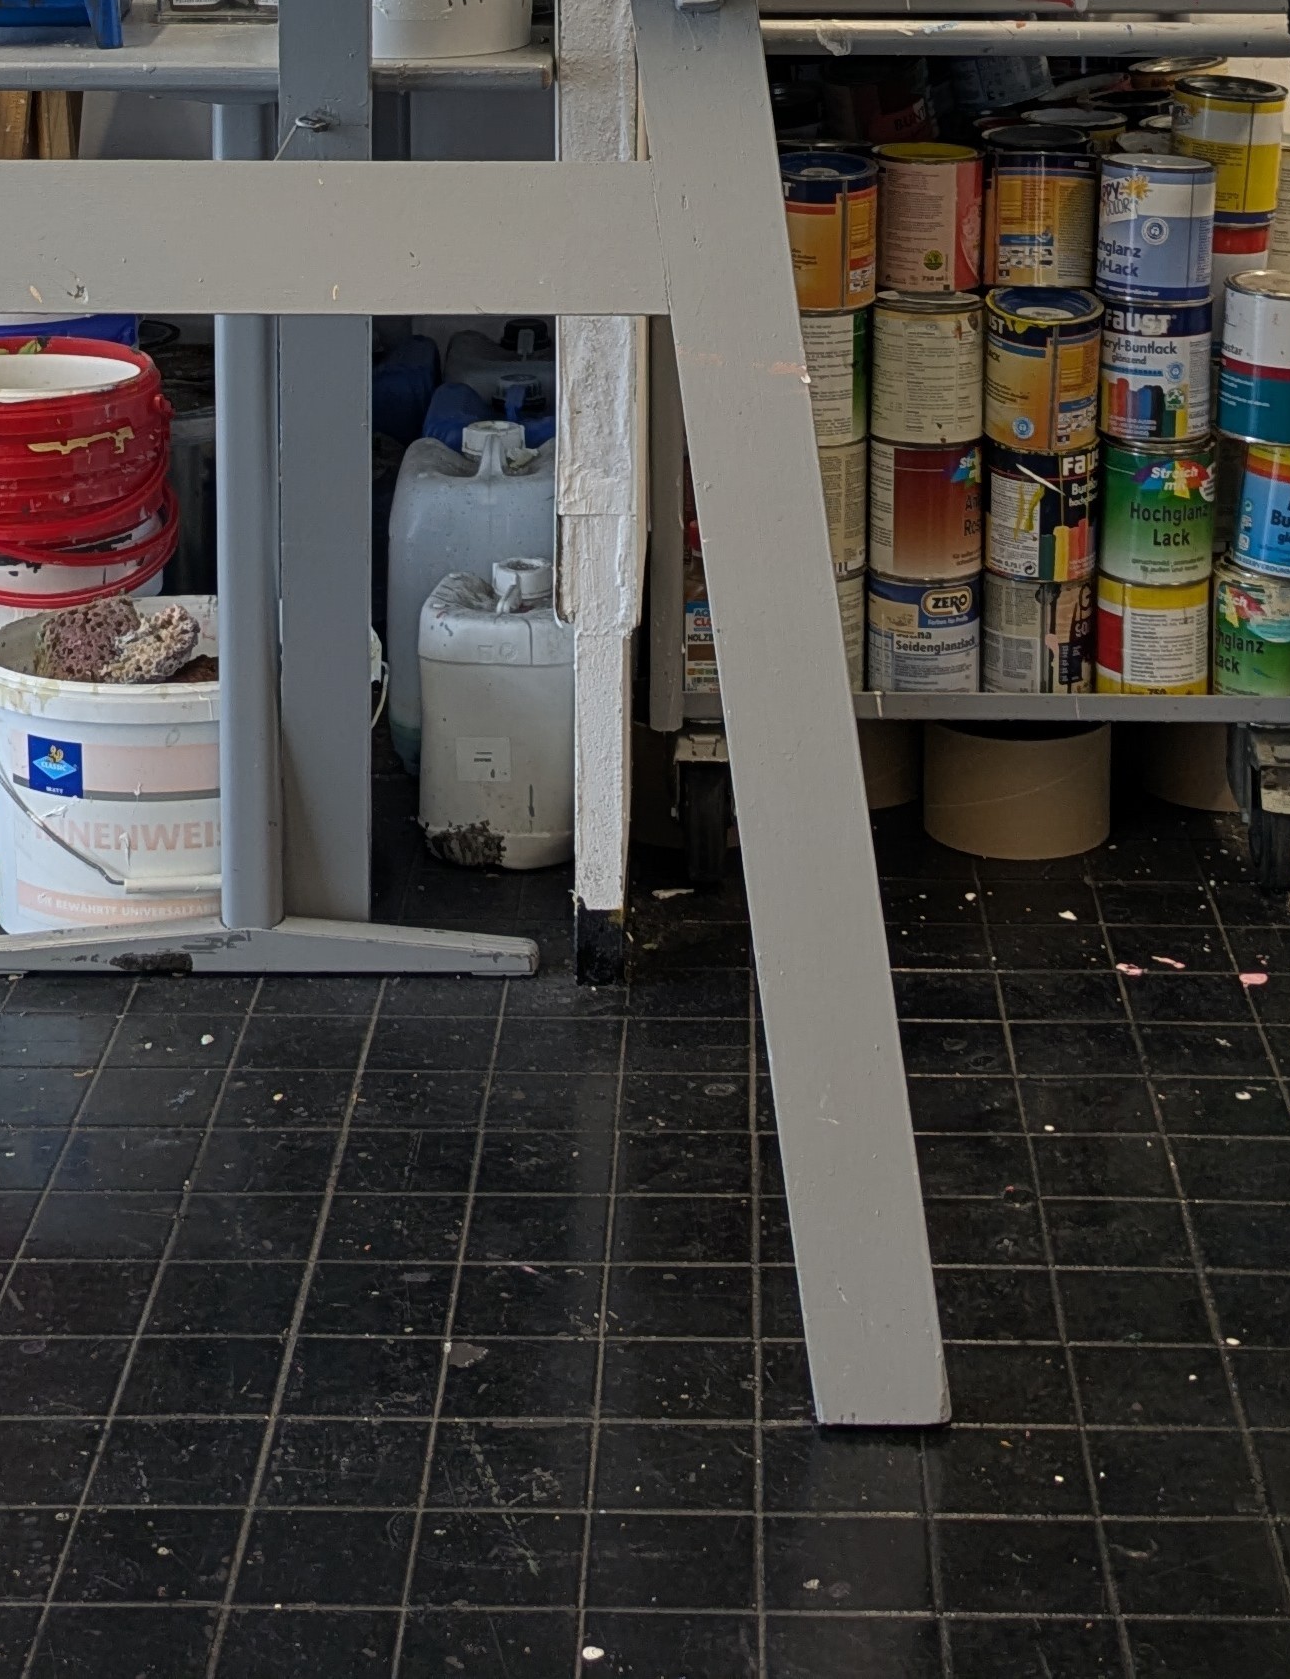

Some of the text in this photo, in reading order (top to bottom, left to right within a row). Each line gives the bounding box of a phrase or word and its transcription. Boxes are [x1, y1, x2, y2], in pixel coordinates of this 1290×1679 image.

[1103, 337, 1178, 355] cryl-Buntlack
[1150, 465, 1199, 480] Streich
[1129, 501, 1209, 526] Hochglanz
[1153, 528, 1191, 547] Lack
[931, 593, 968, 613] ZERO
